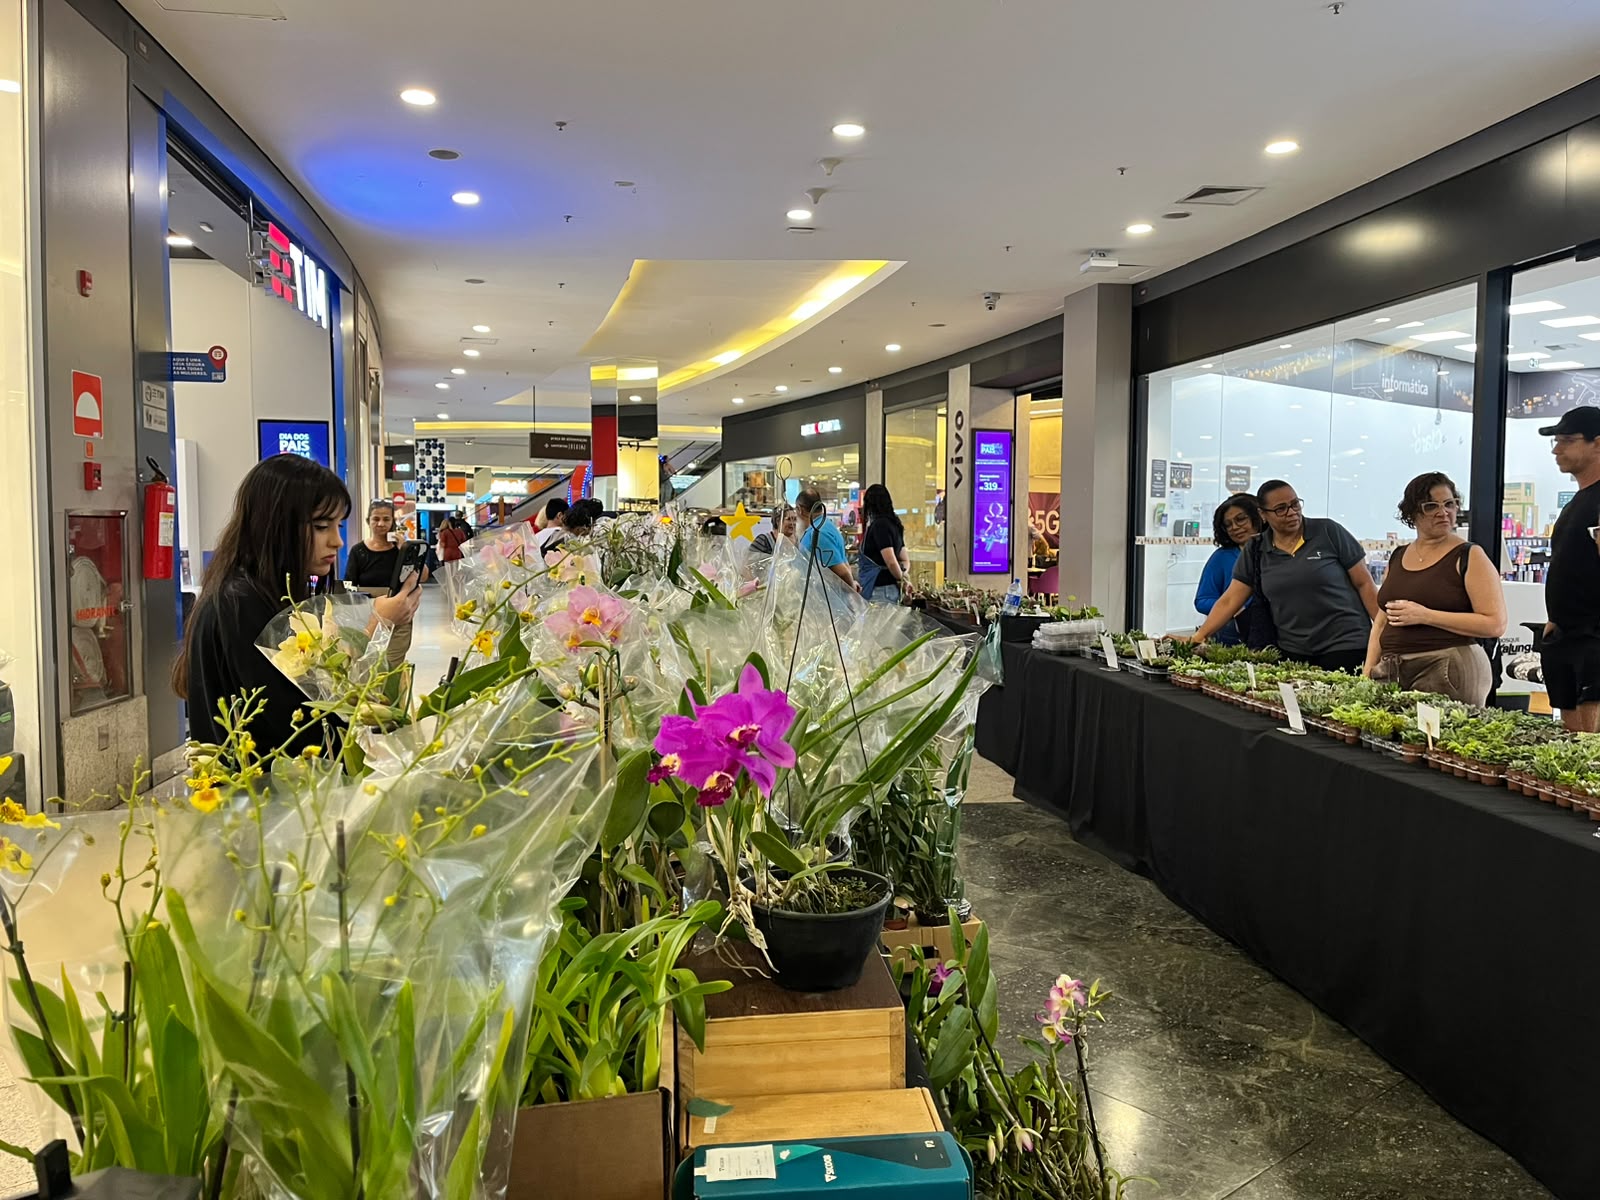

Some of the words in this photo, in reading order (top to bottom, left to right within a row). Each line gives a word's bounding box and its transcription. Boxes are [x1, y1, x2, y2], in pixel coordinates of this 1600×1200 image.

[289, 242, 327, 329] TIM
[1381, 373, 1429, 396] informática
[279, 432, 292, 440] DIA
[279, 440, 310, 452] PAIS
[950, 410, 964, 489] vivo
[984, 482, 998, 490] 319
